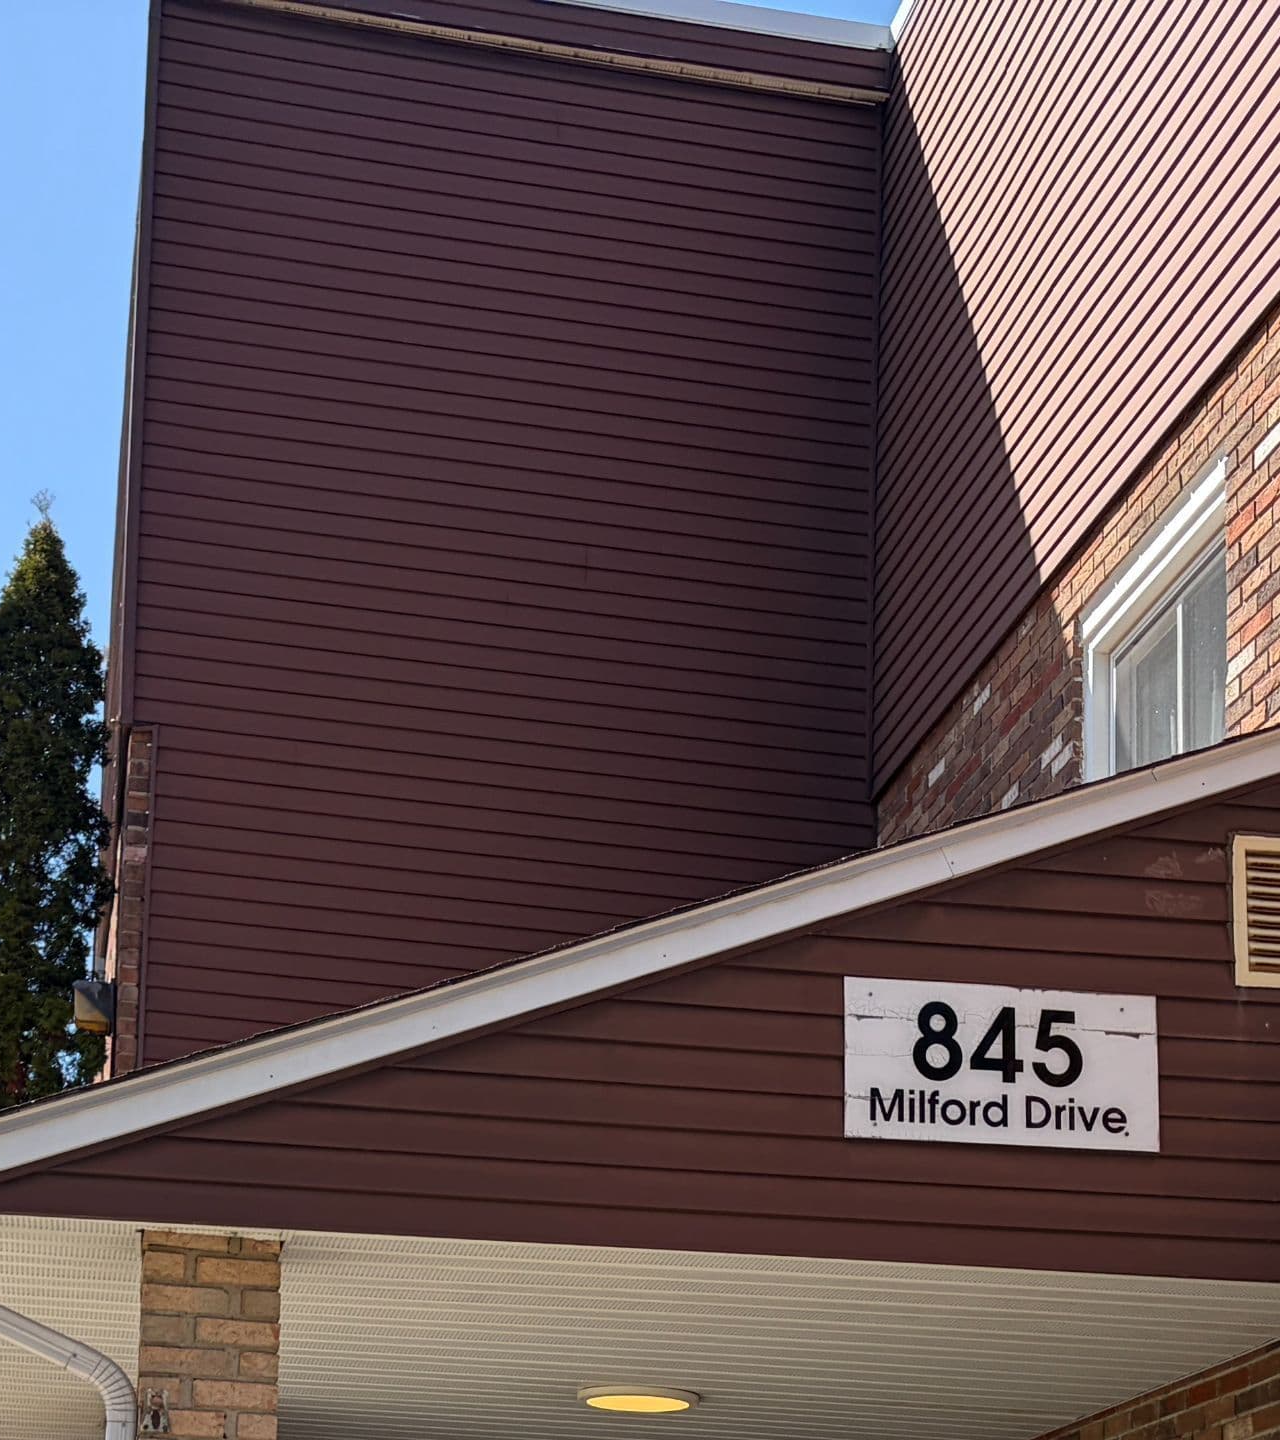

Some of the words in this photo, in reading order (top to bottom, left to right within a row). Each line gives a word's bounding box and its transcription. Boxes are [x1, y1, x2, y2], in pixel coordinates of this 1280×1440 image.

[912, 1001, 1083, 1088] 845
[869, 1087, 1009, 1128] Milford
[1025, 1096, 1127, 1135] Drive
